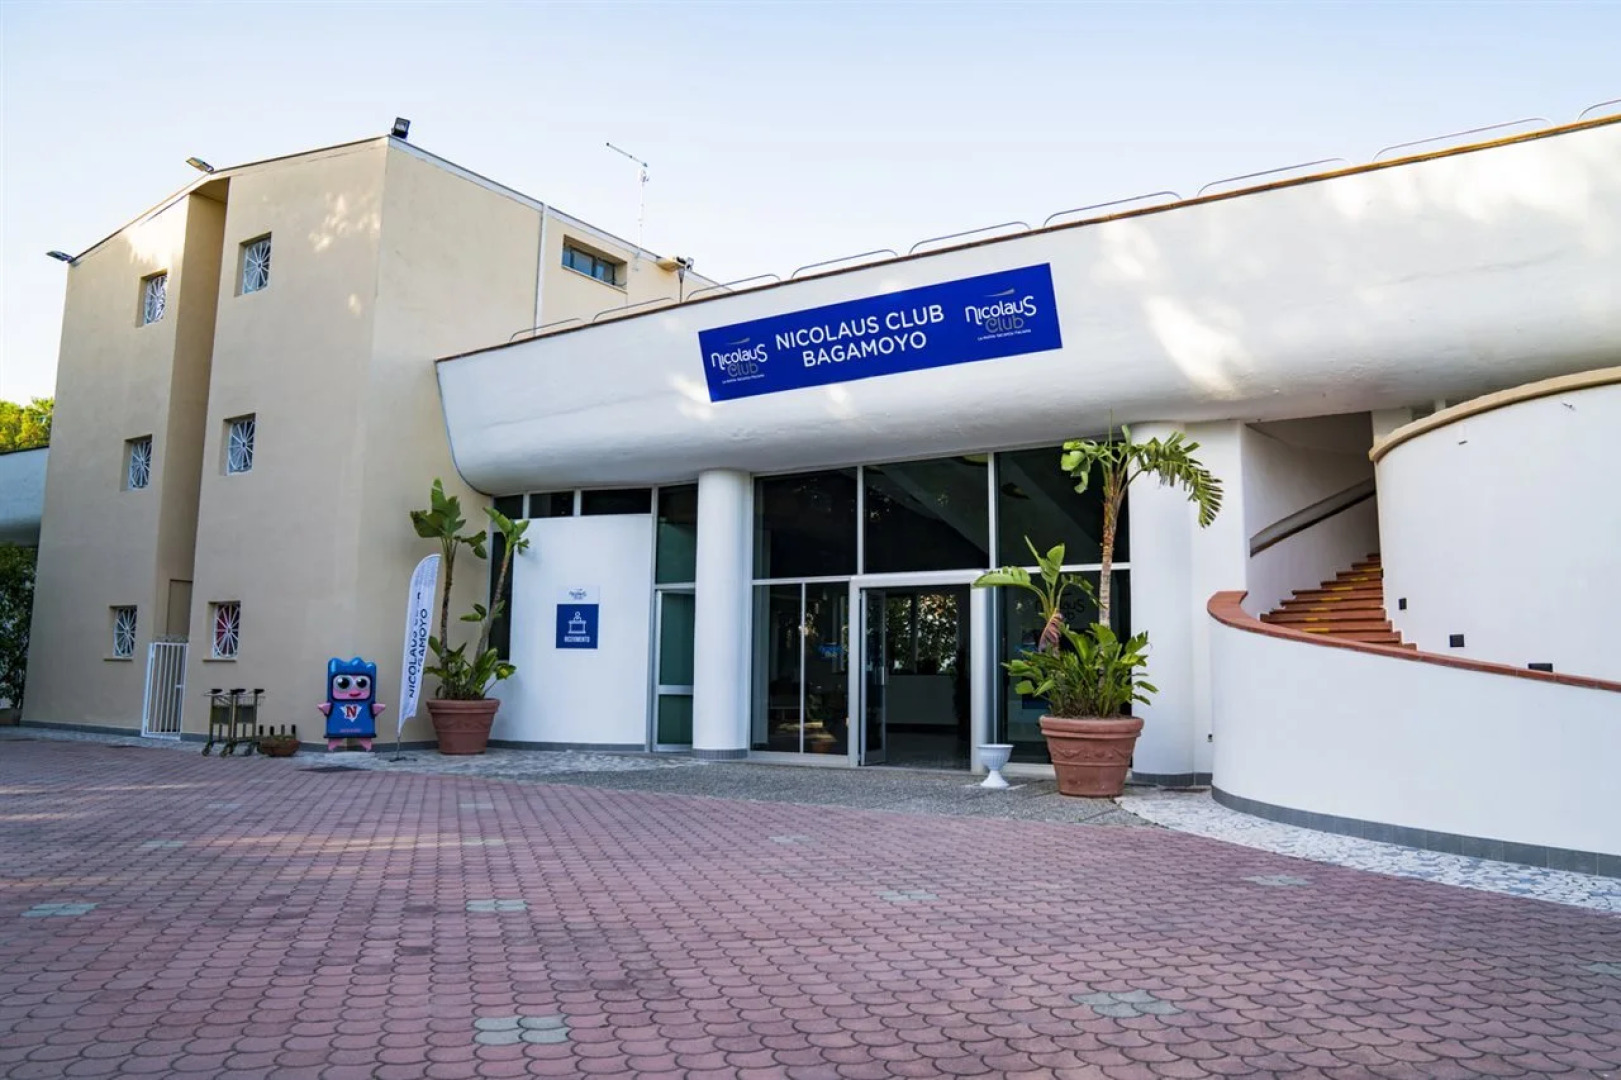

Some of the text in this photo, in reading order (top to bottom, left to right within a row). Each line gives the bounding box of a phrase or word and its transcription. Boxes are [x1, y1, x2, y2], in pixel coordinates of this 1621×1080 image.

[775, 304, 944, 351] NICOLAUS CLUB
[802, 331, 927, 367] BAGAMOYO
[346, 705, 357, 719] N
